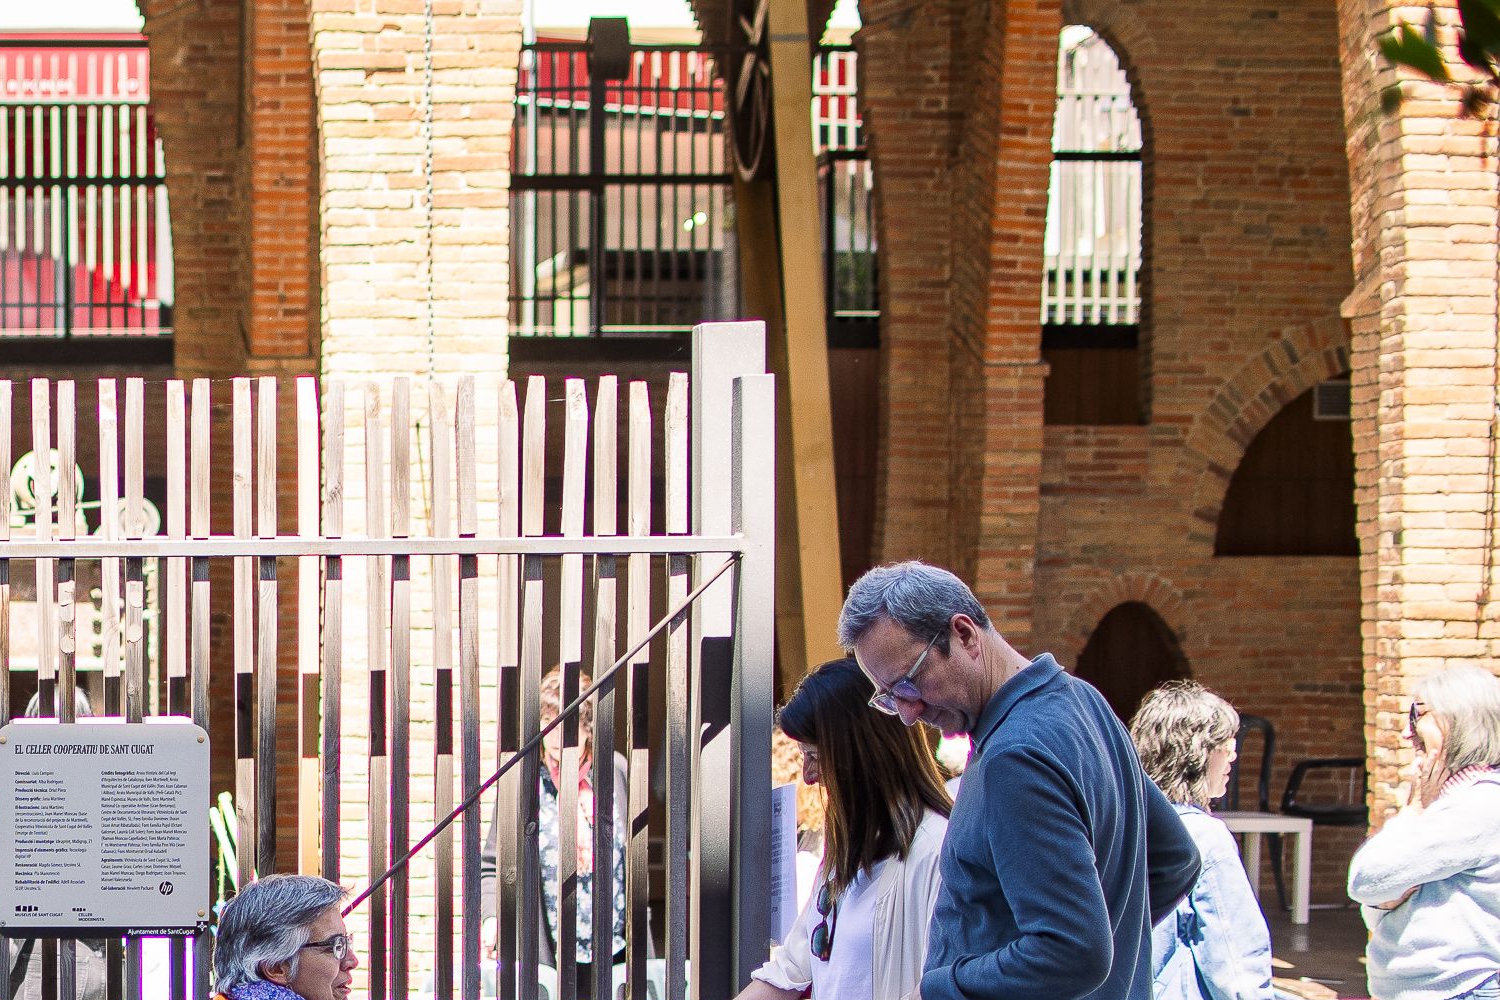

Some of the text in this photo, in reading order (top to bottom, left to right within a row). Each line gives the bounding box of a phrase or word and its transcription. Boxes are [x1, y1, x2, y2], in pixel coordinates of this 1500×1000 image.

[15, 745, 154, 755] EL CELLER COOPERATIU DE SANT CUGAT
[160, 882, 173, 895] hp
